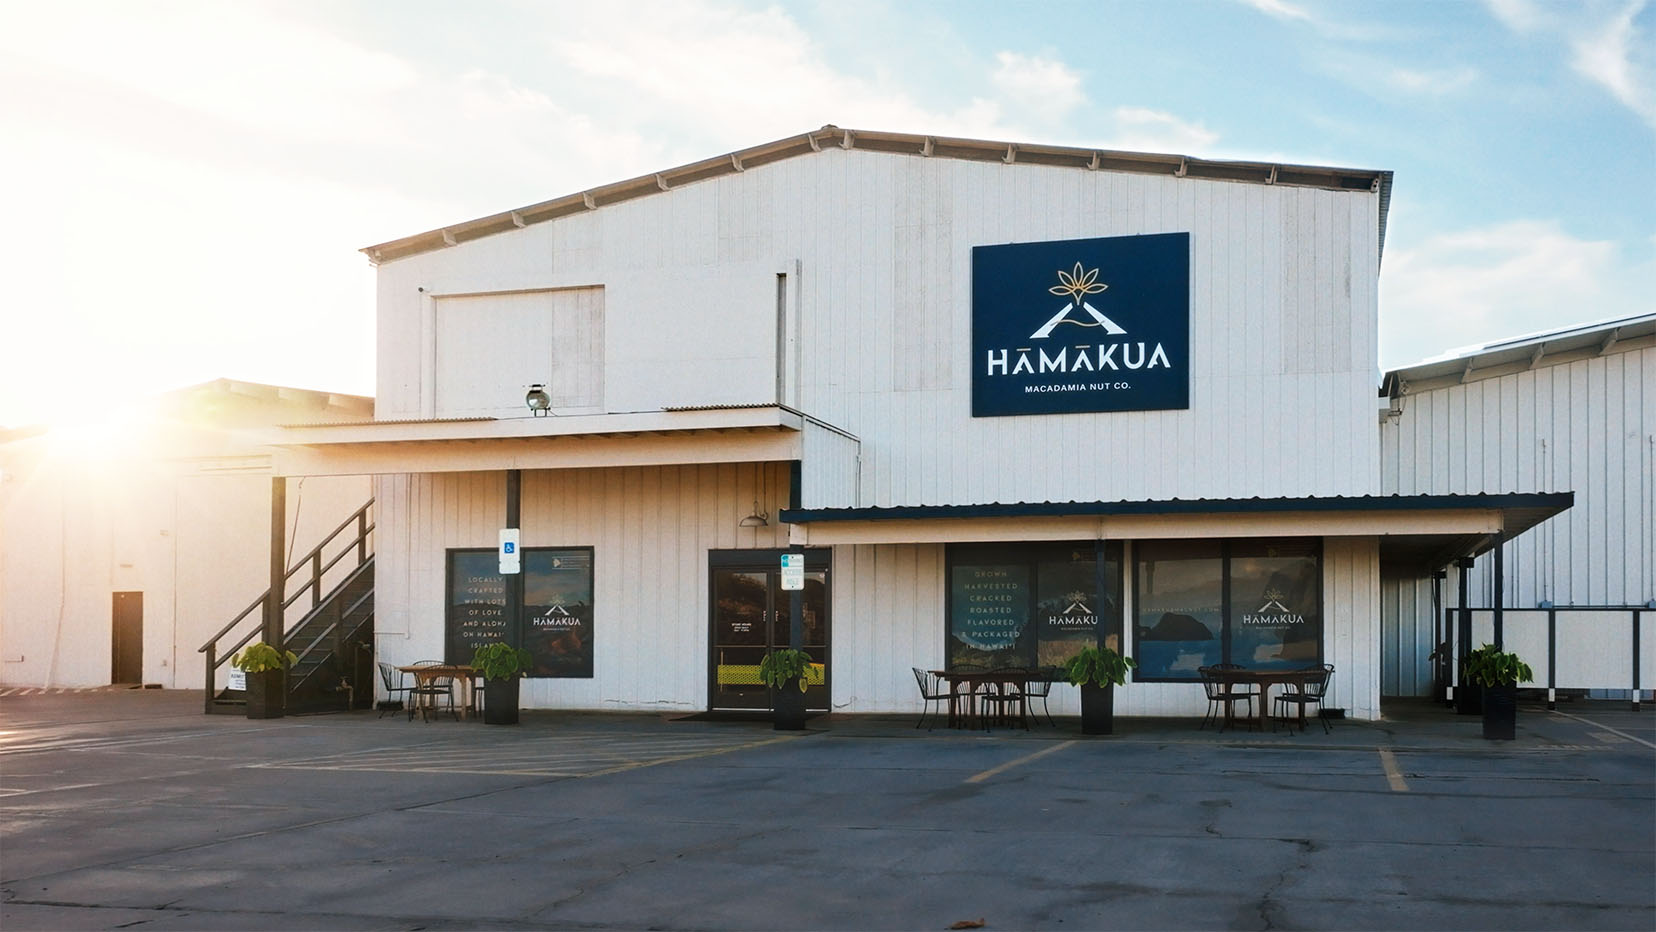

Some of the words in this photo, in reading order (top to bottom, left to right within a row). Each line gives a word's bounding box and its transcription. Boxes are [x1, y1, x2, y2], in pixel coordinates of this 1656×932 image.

[987, 342, 1172, 376] HĀMĀKUA
[1024, 384, 1087, 393] MACADAMIA
[1089, 382, 1111, 391] NUT
[1113, 381, 1132, 390] CO.
[1049, 615, 1099, 625] HĀMĀKU
